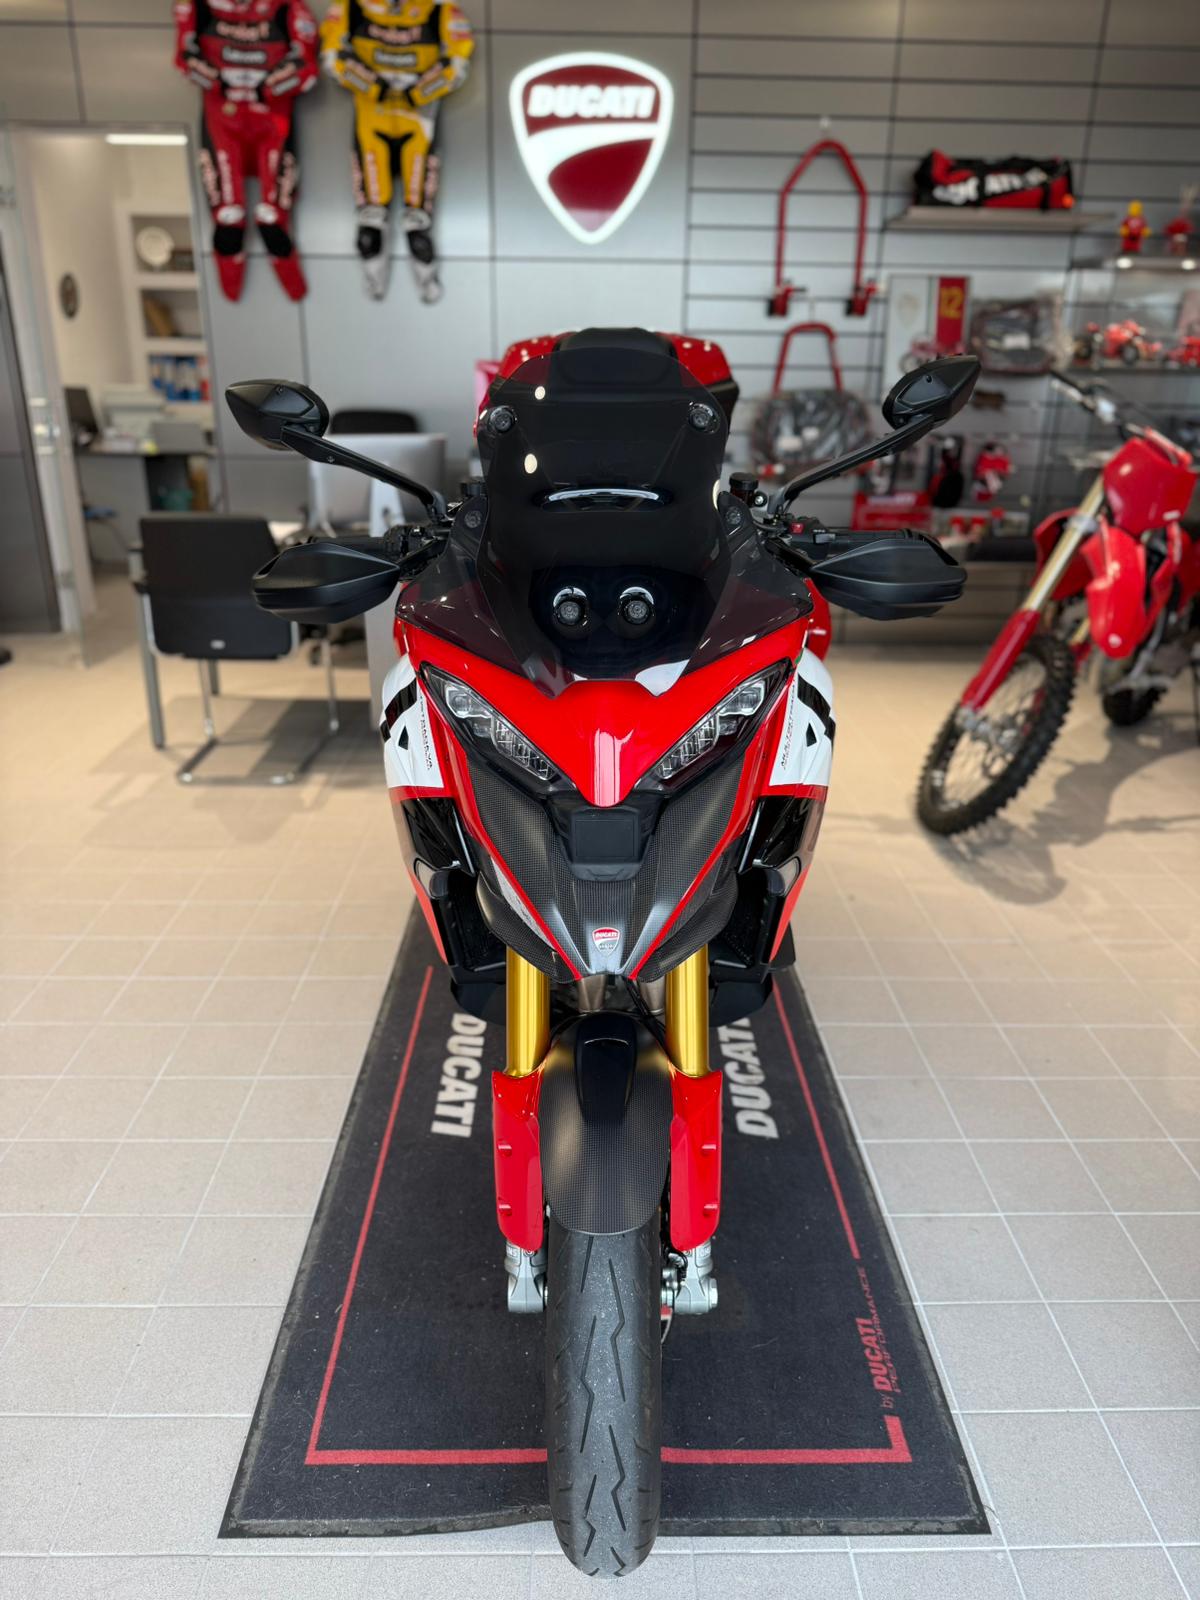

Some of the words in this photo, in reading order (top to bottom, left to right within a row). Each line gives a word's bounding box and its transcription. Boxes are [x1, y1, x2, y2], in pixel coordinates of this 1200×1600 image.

[527, 84, 656, 118] DUCATI
[430, 1012, 487, 1138] DUCATI
[855, 1317, 893, 1392] DUCATI
